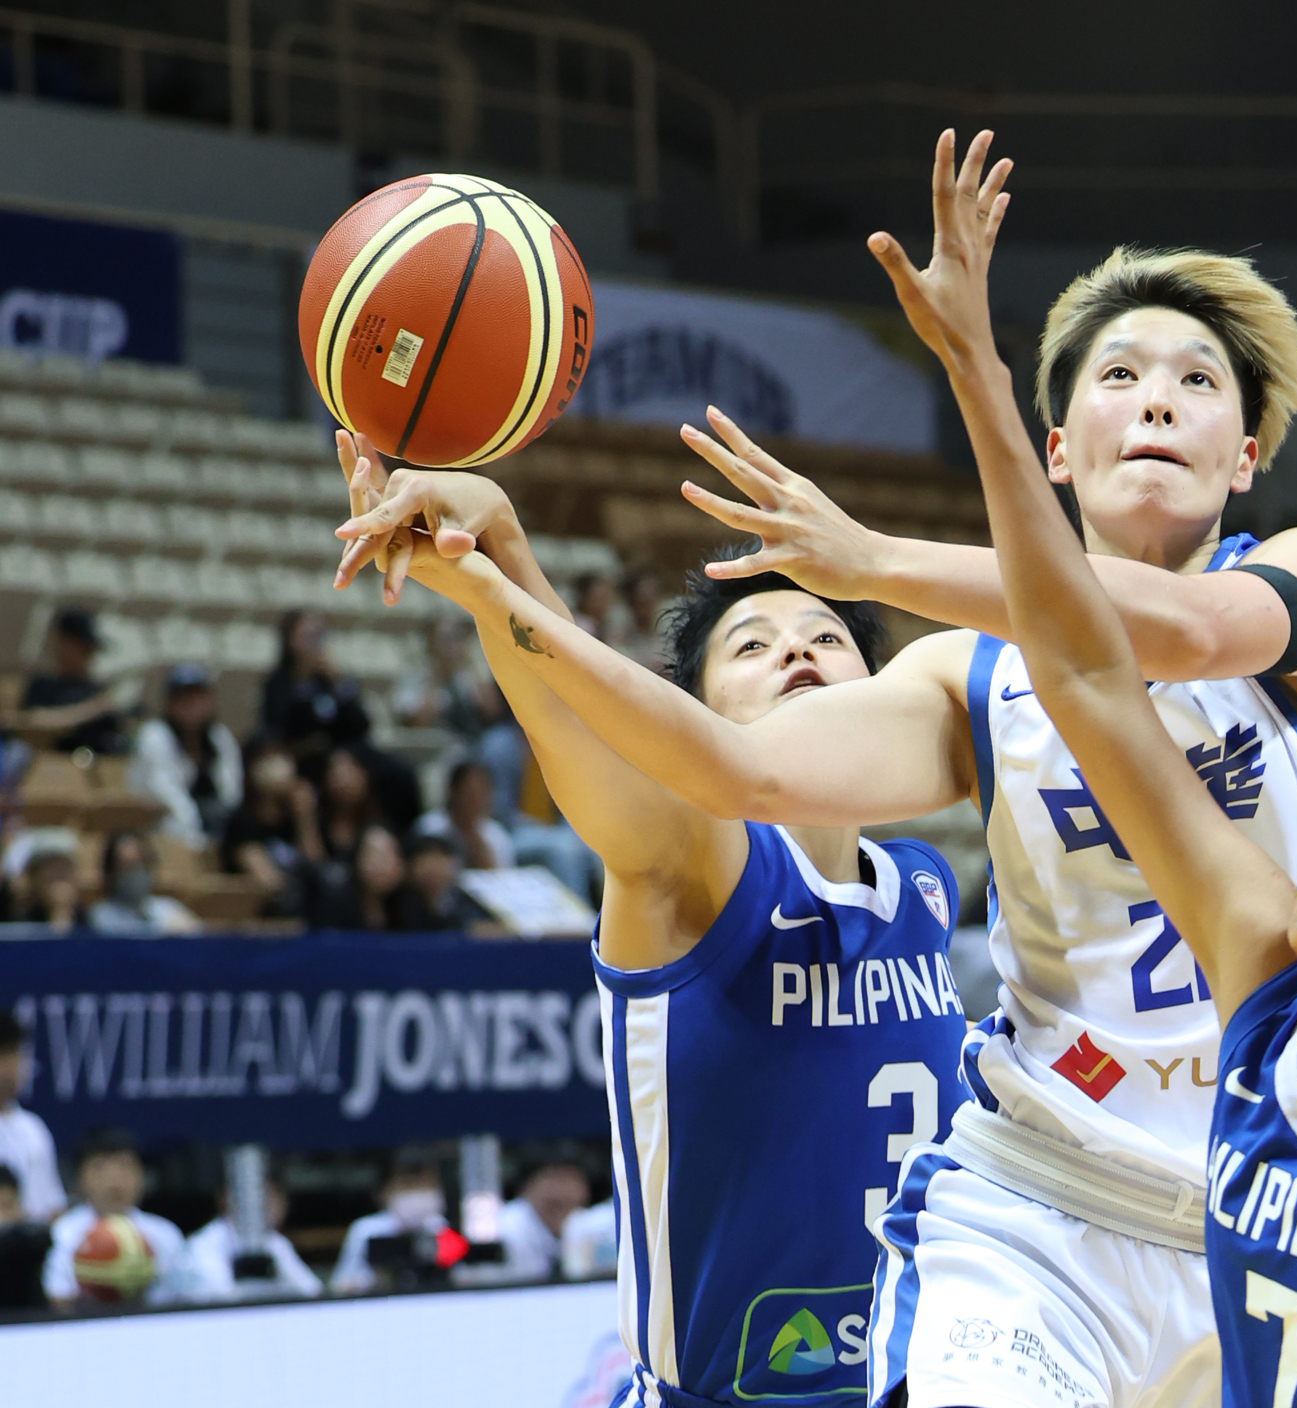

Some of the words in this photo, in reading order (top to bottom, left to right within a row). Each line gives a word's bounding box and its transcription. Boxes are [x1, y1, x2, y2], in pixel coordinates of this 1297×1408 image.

[771, 951, 964, 1027] PILIPINA
[1127, 900, 1214, 1013] 2
[43, 991, 345, 1099] WILLIAM
[340, 988, 571, 1120] JONES
